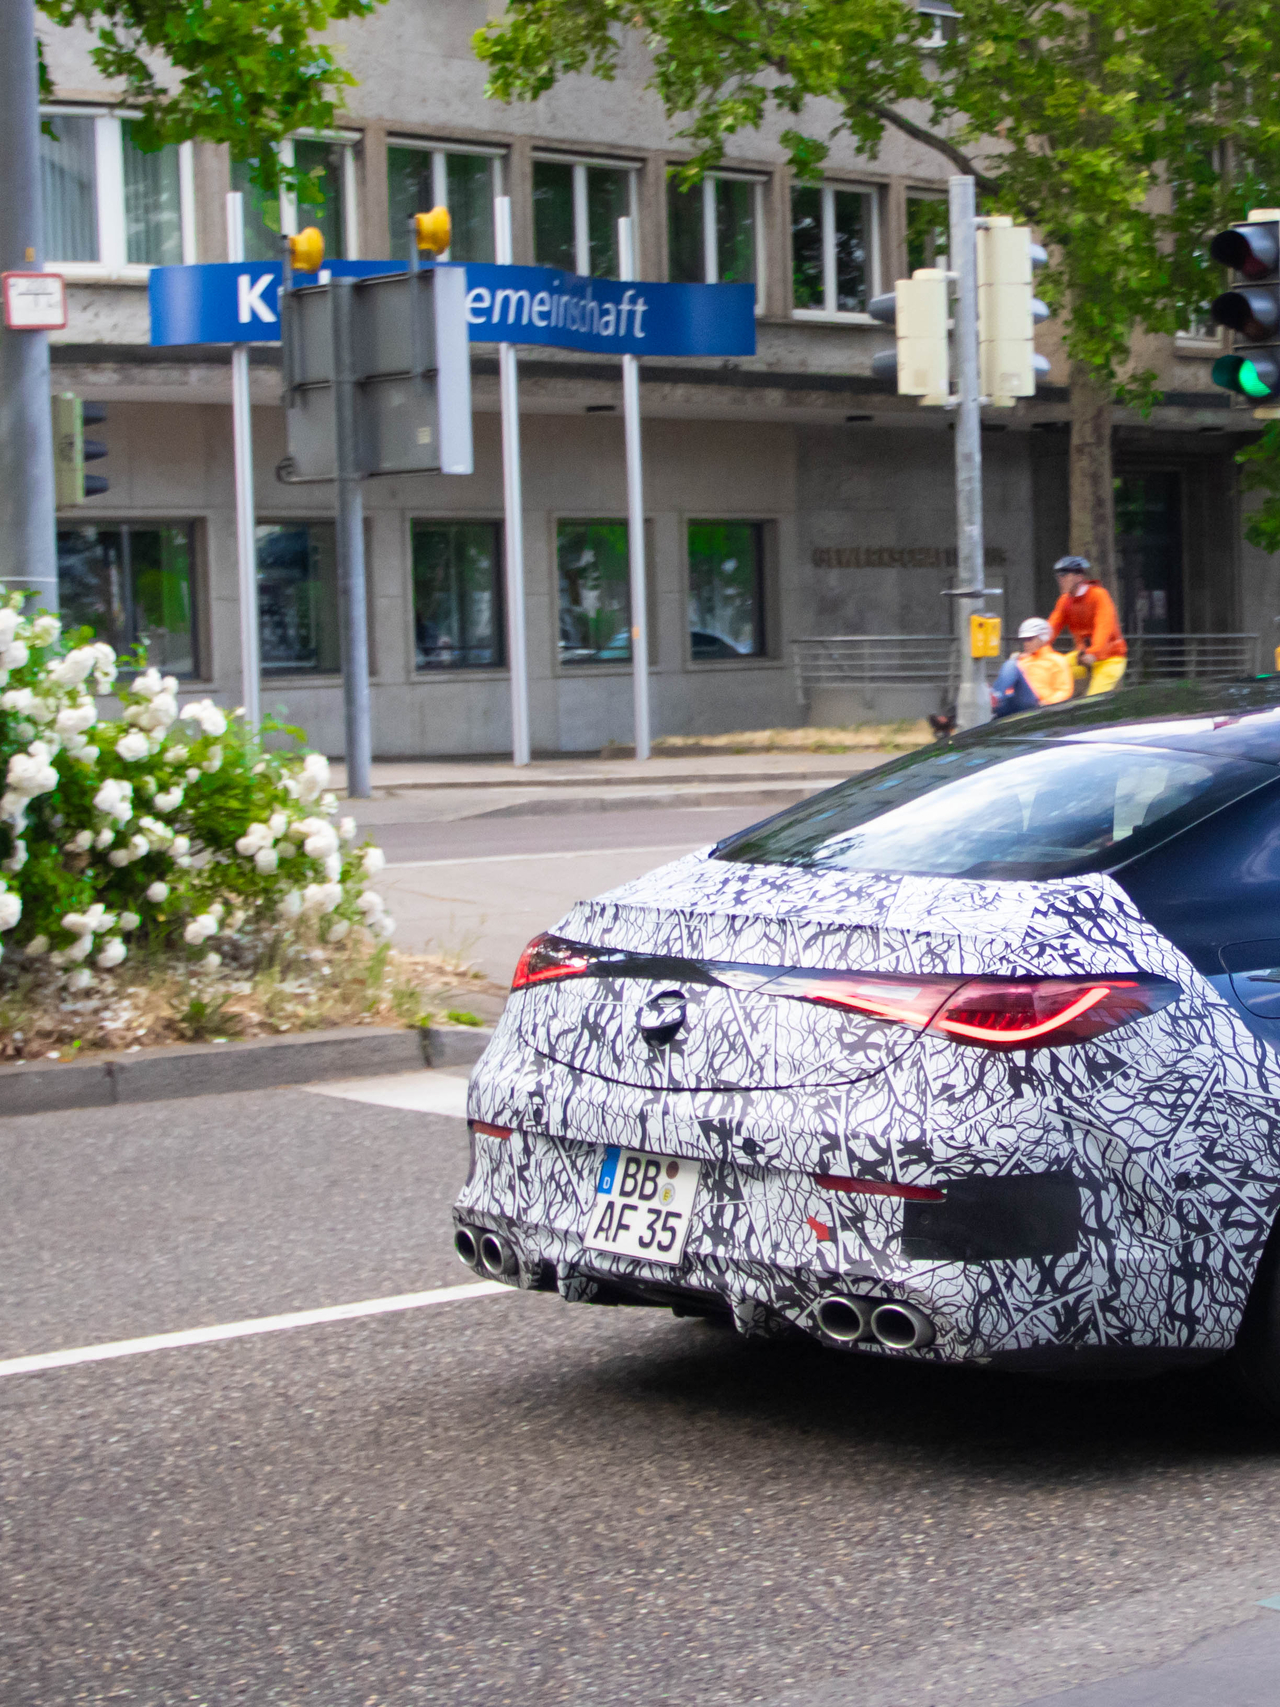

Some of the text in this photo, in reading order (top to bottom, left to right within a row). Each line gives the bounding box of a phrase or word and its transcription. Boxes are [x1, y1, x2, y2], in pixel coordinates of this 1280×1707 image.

[464, 279, 649, 338] emeinschaft
[619, 1156, 661, 1201] BB
[593, 1200, 682, 1253] AF 35
